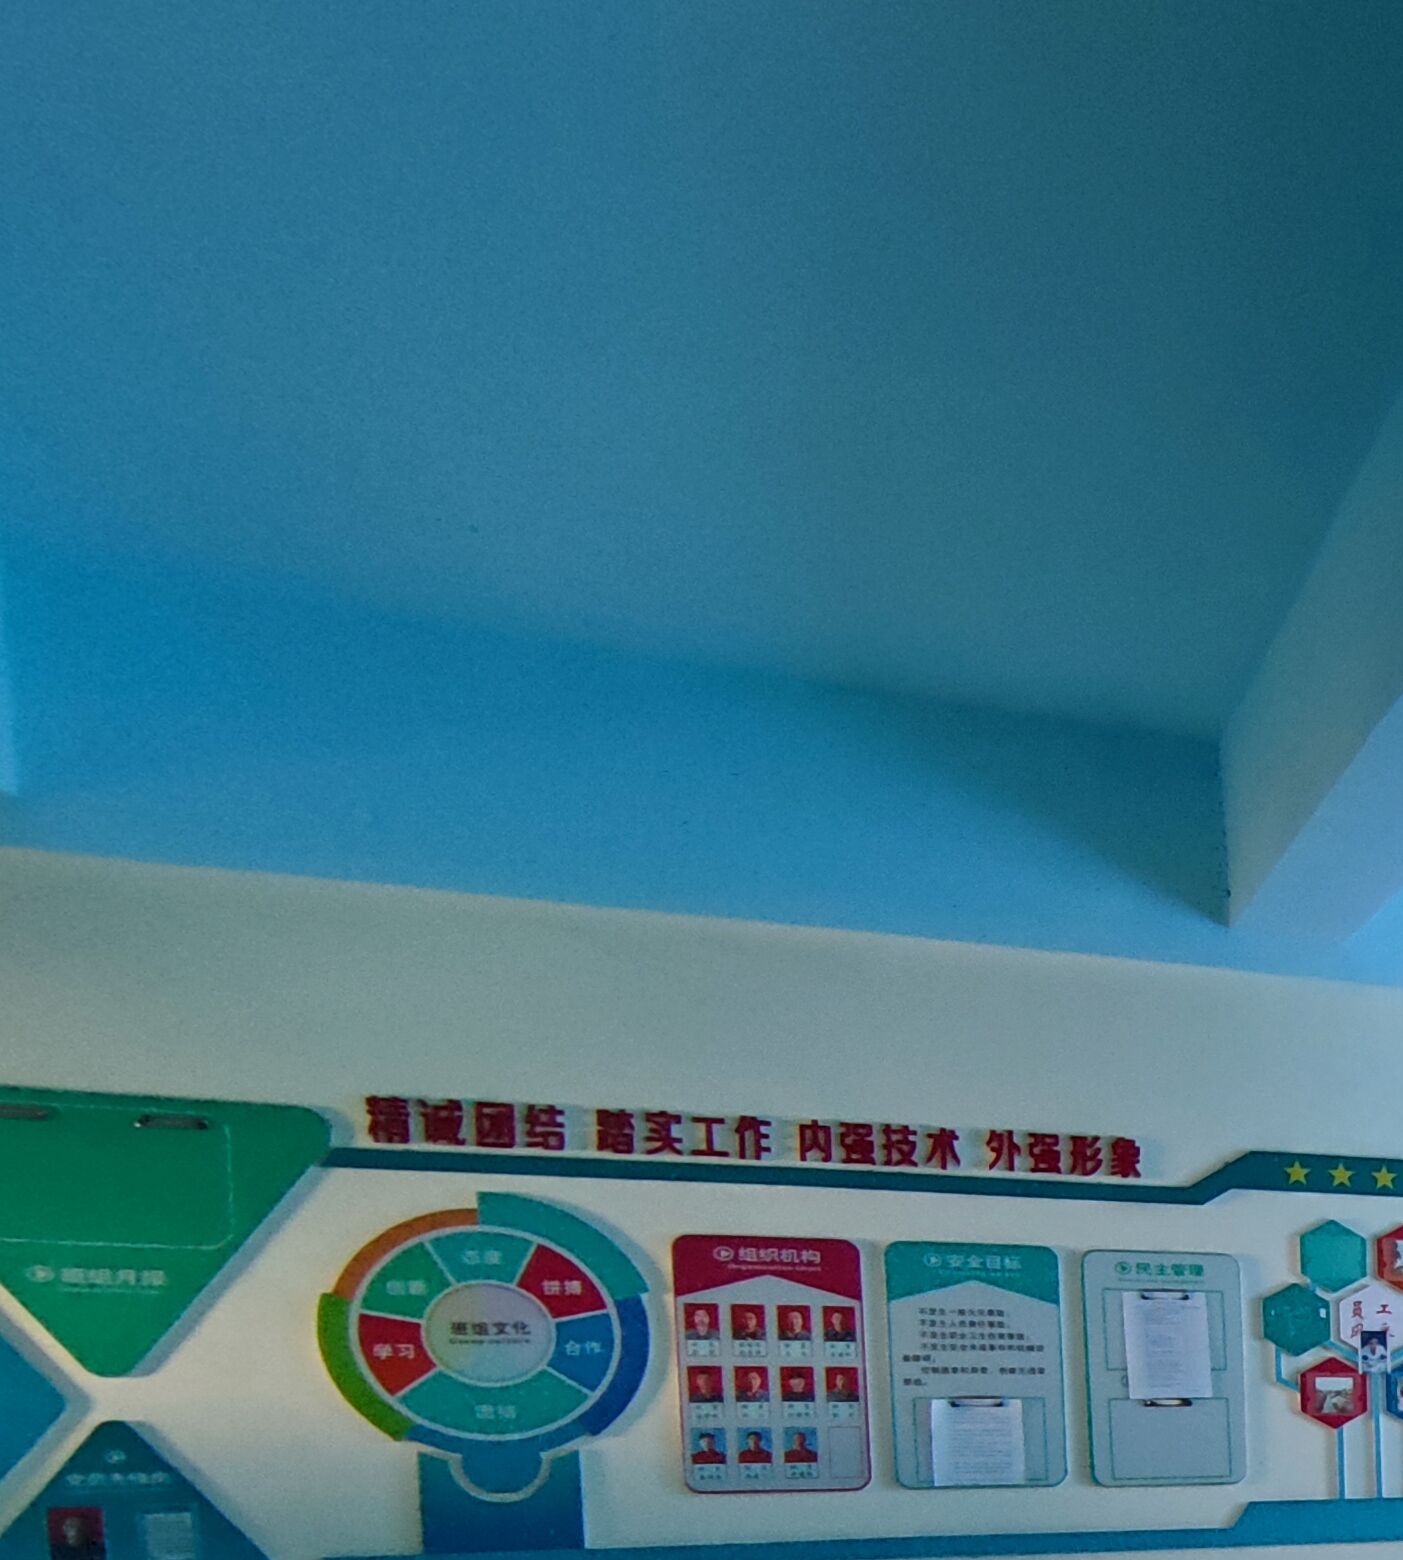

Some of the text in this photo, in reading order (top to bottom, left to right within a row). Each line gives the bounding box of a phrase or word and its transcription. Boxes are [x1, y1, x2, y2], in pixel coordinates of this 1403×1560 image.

[365, 1095, 1142, 1178] 精诚团结 踏实工作 内强技术 外强形象
[738, 1247, 821, 1265] 组织机构
[946, 1255, 1022, 1270] 安全目标
[1135, 1262, 1205, 1277] 民主管理
[372, 1342, 416, 1360] 学习
